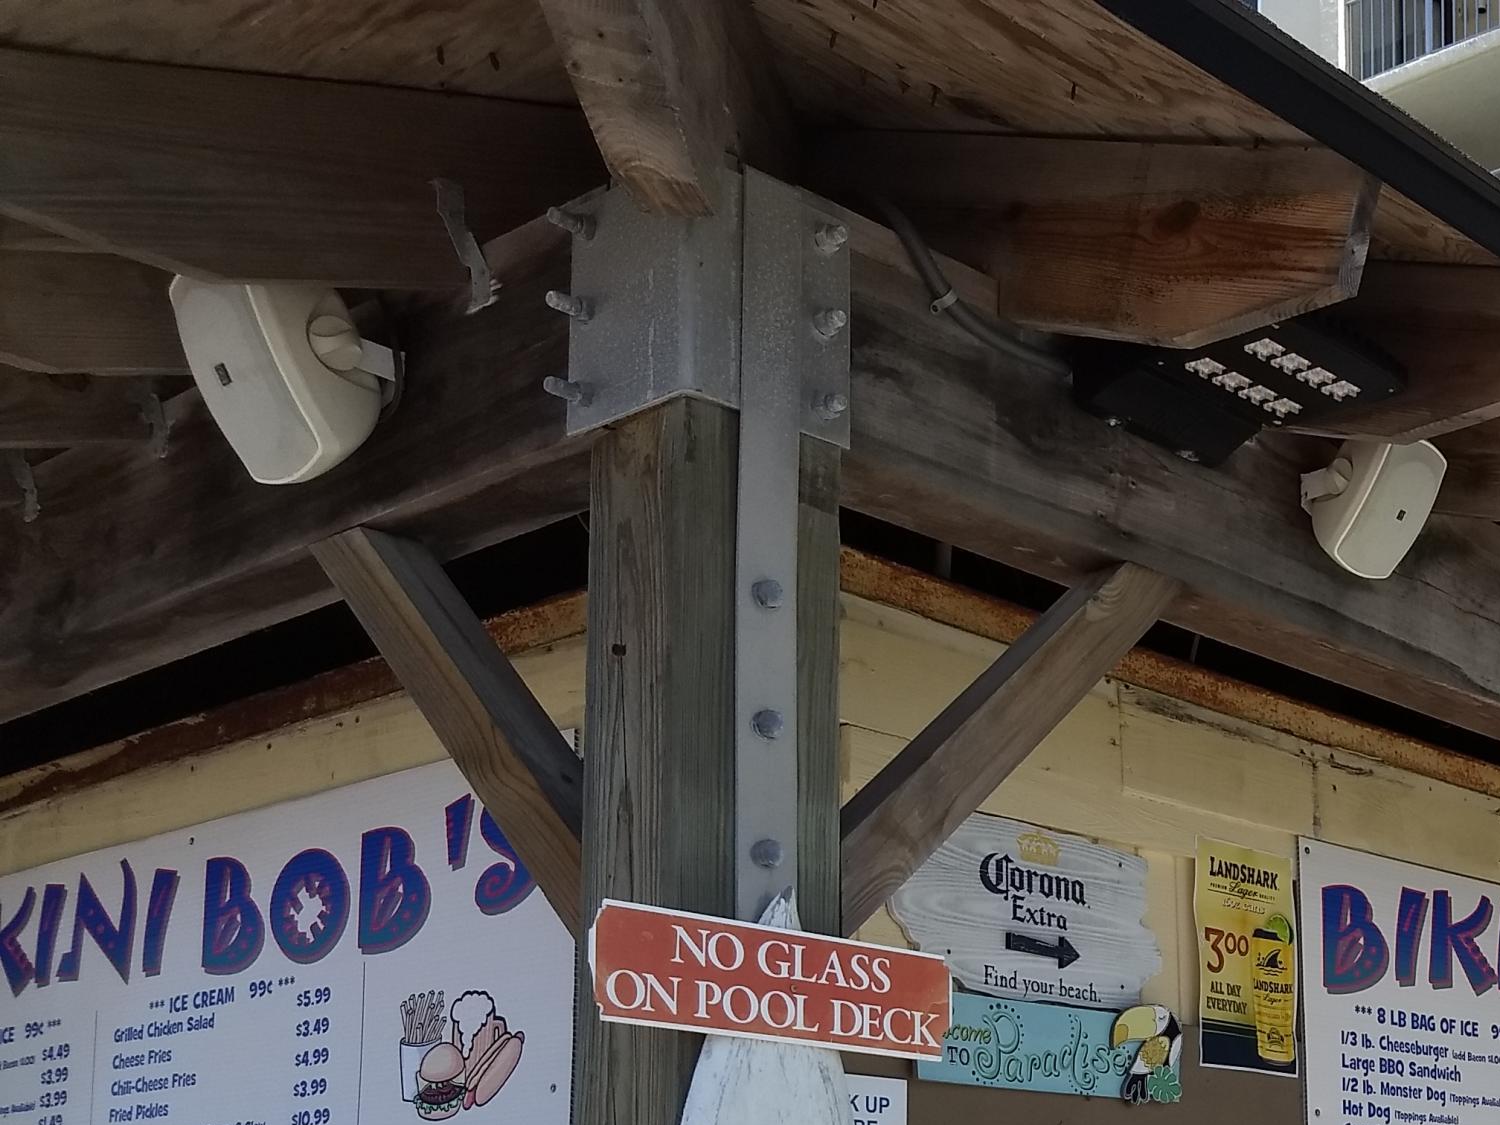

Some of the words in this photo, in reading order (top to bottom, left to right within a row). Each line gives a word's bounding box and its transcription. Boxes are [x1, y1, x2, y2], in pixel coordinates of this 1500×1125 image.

[980, 853, 1087, 906] Corona
[1209, 856, 1278, 891] LANDSHARK
[1229, 881, 1258, 899] Lager
[0, 858, 180, 998] KINI
[202, 793, 538, 976] BOB'S
[1011, 894, 1068, 931] Extra
[671, 925, 744, 971] NO
[757, 941, 891, 993] GLASS
[168, 994, 189, 1014] ICE
[192, 985, 235, 1010] CREAM
[984, 965, 1017, 989] Find
[1023, 978, 1054, 998] your
[1059, 978, 1101, 1003] beach.
[1210, 981, 1224, 995] ALL
[1226, 983, 1242, 997] DAY
[1253, 978, 1293, 994] LANDSHARK
[113, 1023, 145, 1044] Grilled
[146, 1019, 184, 1038] Chicken
[186, 1011, 216, 1032] Salad
[296, 986, 331, 1008] $5.99
[606, 970, 682, 1015] ON
[694, 981, 818, 1032] POOL
[830, 1000, 942, 1048] DECK
[1206, 996, 1247, 1015] EVERYDAY
[1376, 1007, 1387, 1025] 8
[1390, 1009, 1407, 1028] LB
[1410, 1011, 1436, 1032] BAG
[1439, 1017, 1457, 1035] OF
[1460, 1019, 1479, 1038] ICE
[112, 1052, 146, 1070] Cheese
[147, 1049, 173, 1065] Fries
[295, 1016, 330, 1038] $3.49
[943, 1023, 991, 1044] come
[947, 1046, 970, 1066] TO
[973, 1011, 1127, 1090] Paradise
[1340, 1029, 1358, 1047] 1/3
[1378, 1034, 1450, 1063] Cheeseburger
[1341, 1052, 1376, 1078] Large
[1378, 1056, 1405, 1078] BBQ
[1408, 1061, 1462, 1083] Sandwich
[108, 1105, 134, 1124] Fried
[134, 1102, 169, 1120] Pickles
[292, 1077, 328, 1098] $3.99
[866, 1096, 890, 1114] UP
[1341, 1076, 1359, 1093] 1/2
[1380, 1080, 1424, 1100] Monster
[1426, 1085, 1447, 1108] Dog
[1342, 1098, 1364, 1117] Hot
[1367, 1101, 1391, 1125] Dog
